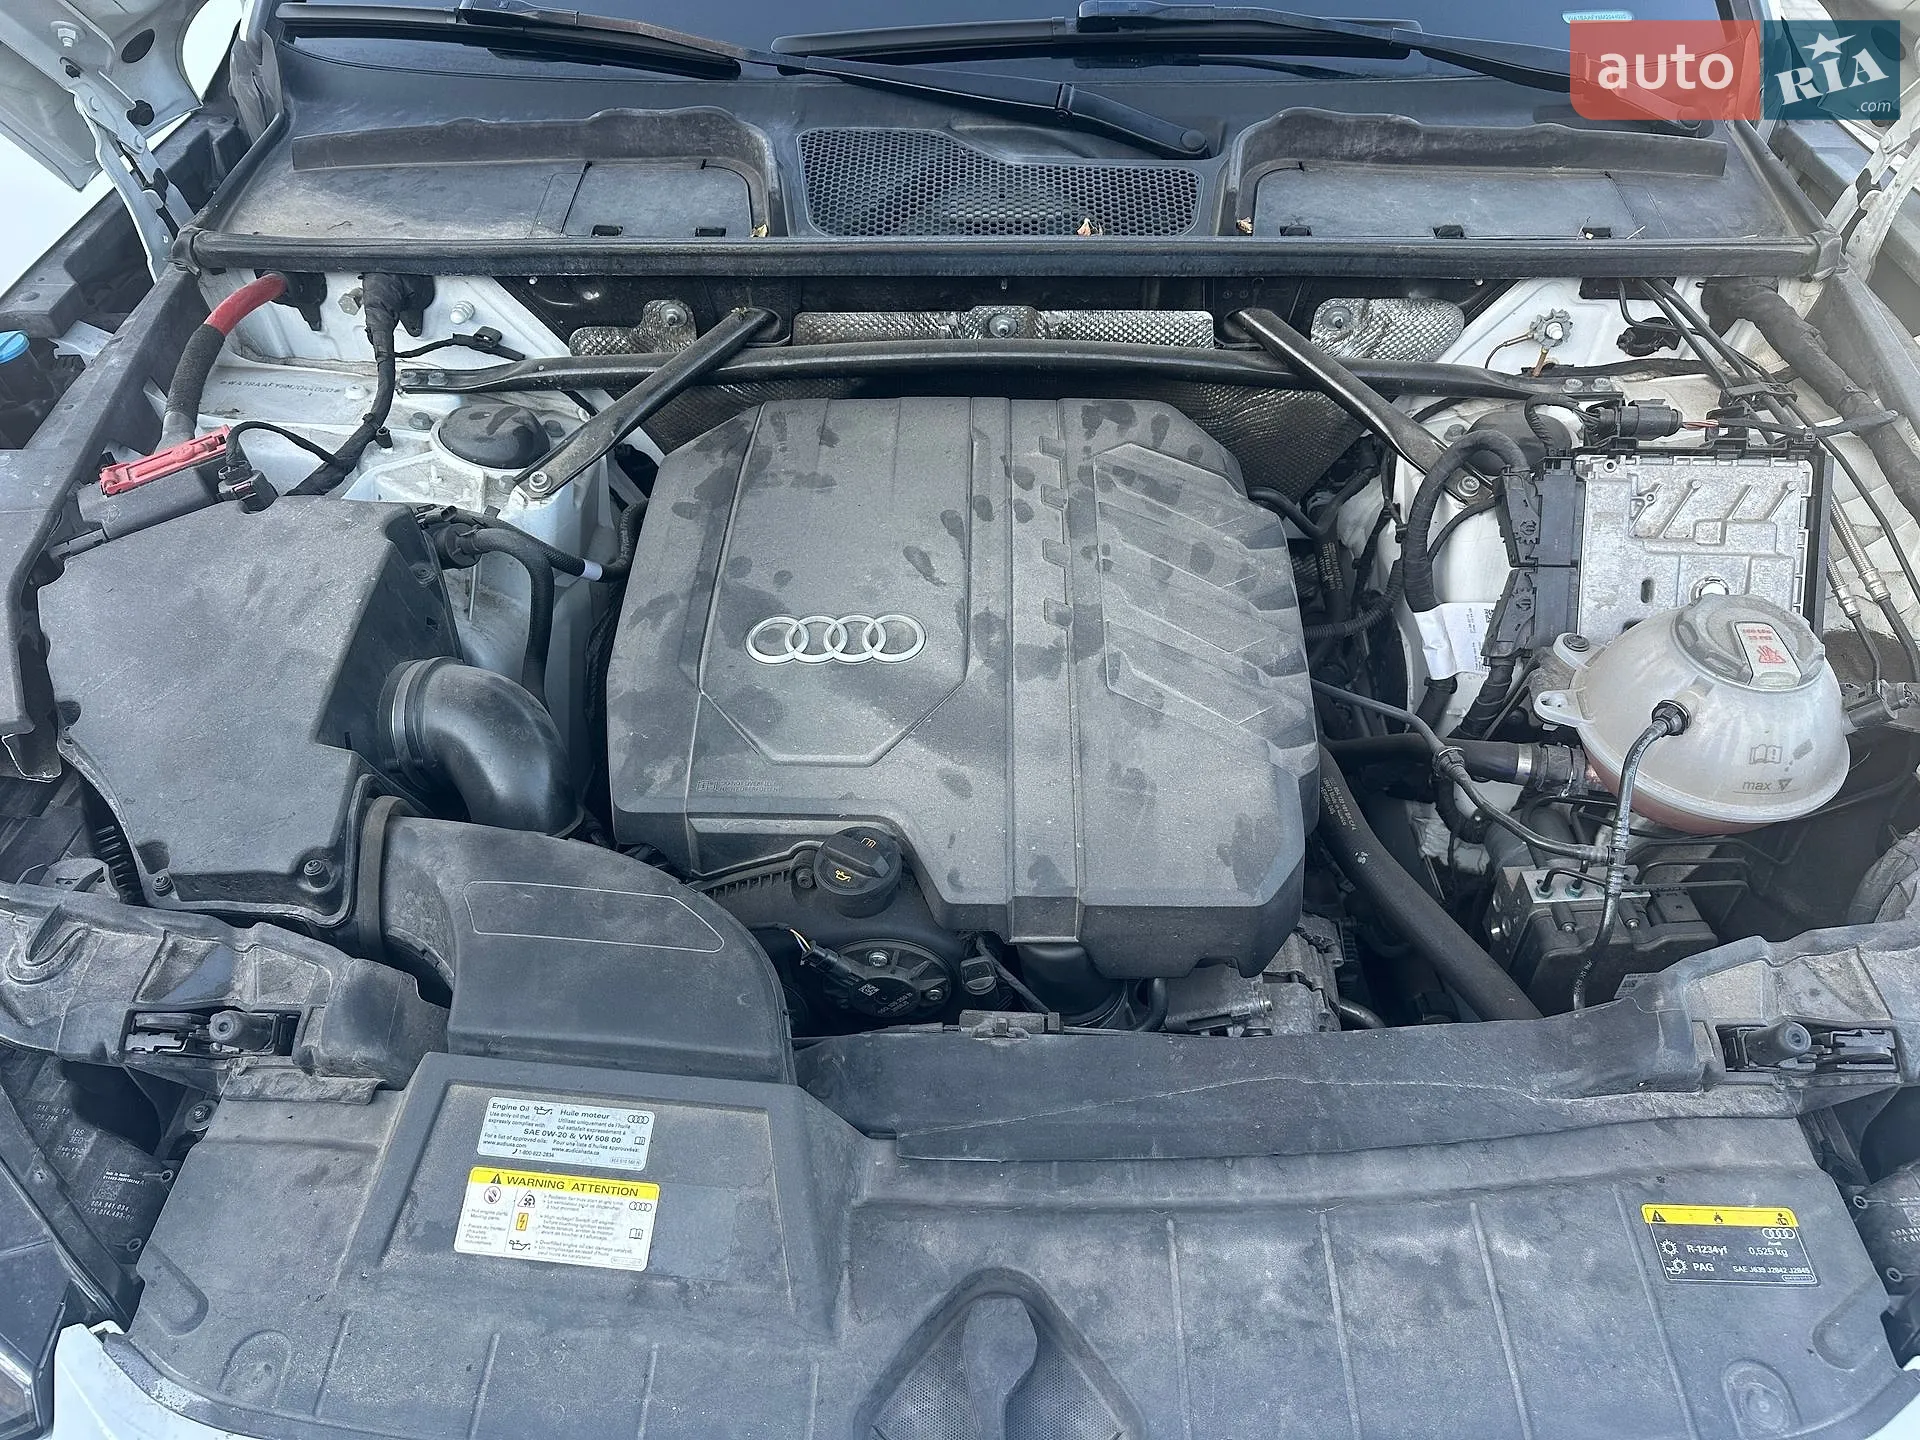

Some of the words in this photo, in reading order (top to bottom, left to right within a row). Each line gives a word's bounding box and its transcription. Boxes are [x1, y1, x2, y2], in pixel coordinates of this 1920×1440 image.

[1742, 780, 1772, 791] max
[491, 1102, 517, 1111] Engine
[523, 1127, 540, 1135] SAE
[541, 1129, 567, 1138] 0W-20
[594, 1134, 609, 1142] 508
[506, 1176, 565, 1189] WARNING
[571, 1182, 638, 1196] ATTENTION
[1685, 1245, 1729, 1255] R-1234yf
[1748, 1247, 1774, 1256] 0,525
[1774, 1247, 1789, 1257] kg
[1692, 1263, 1715, 1271] PAG
